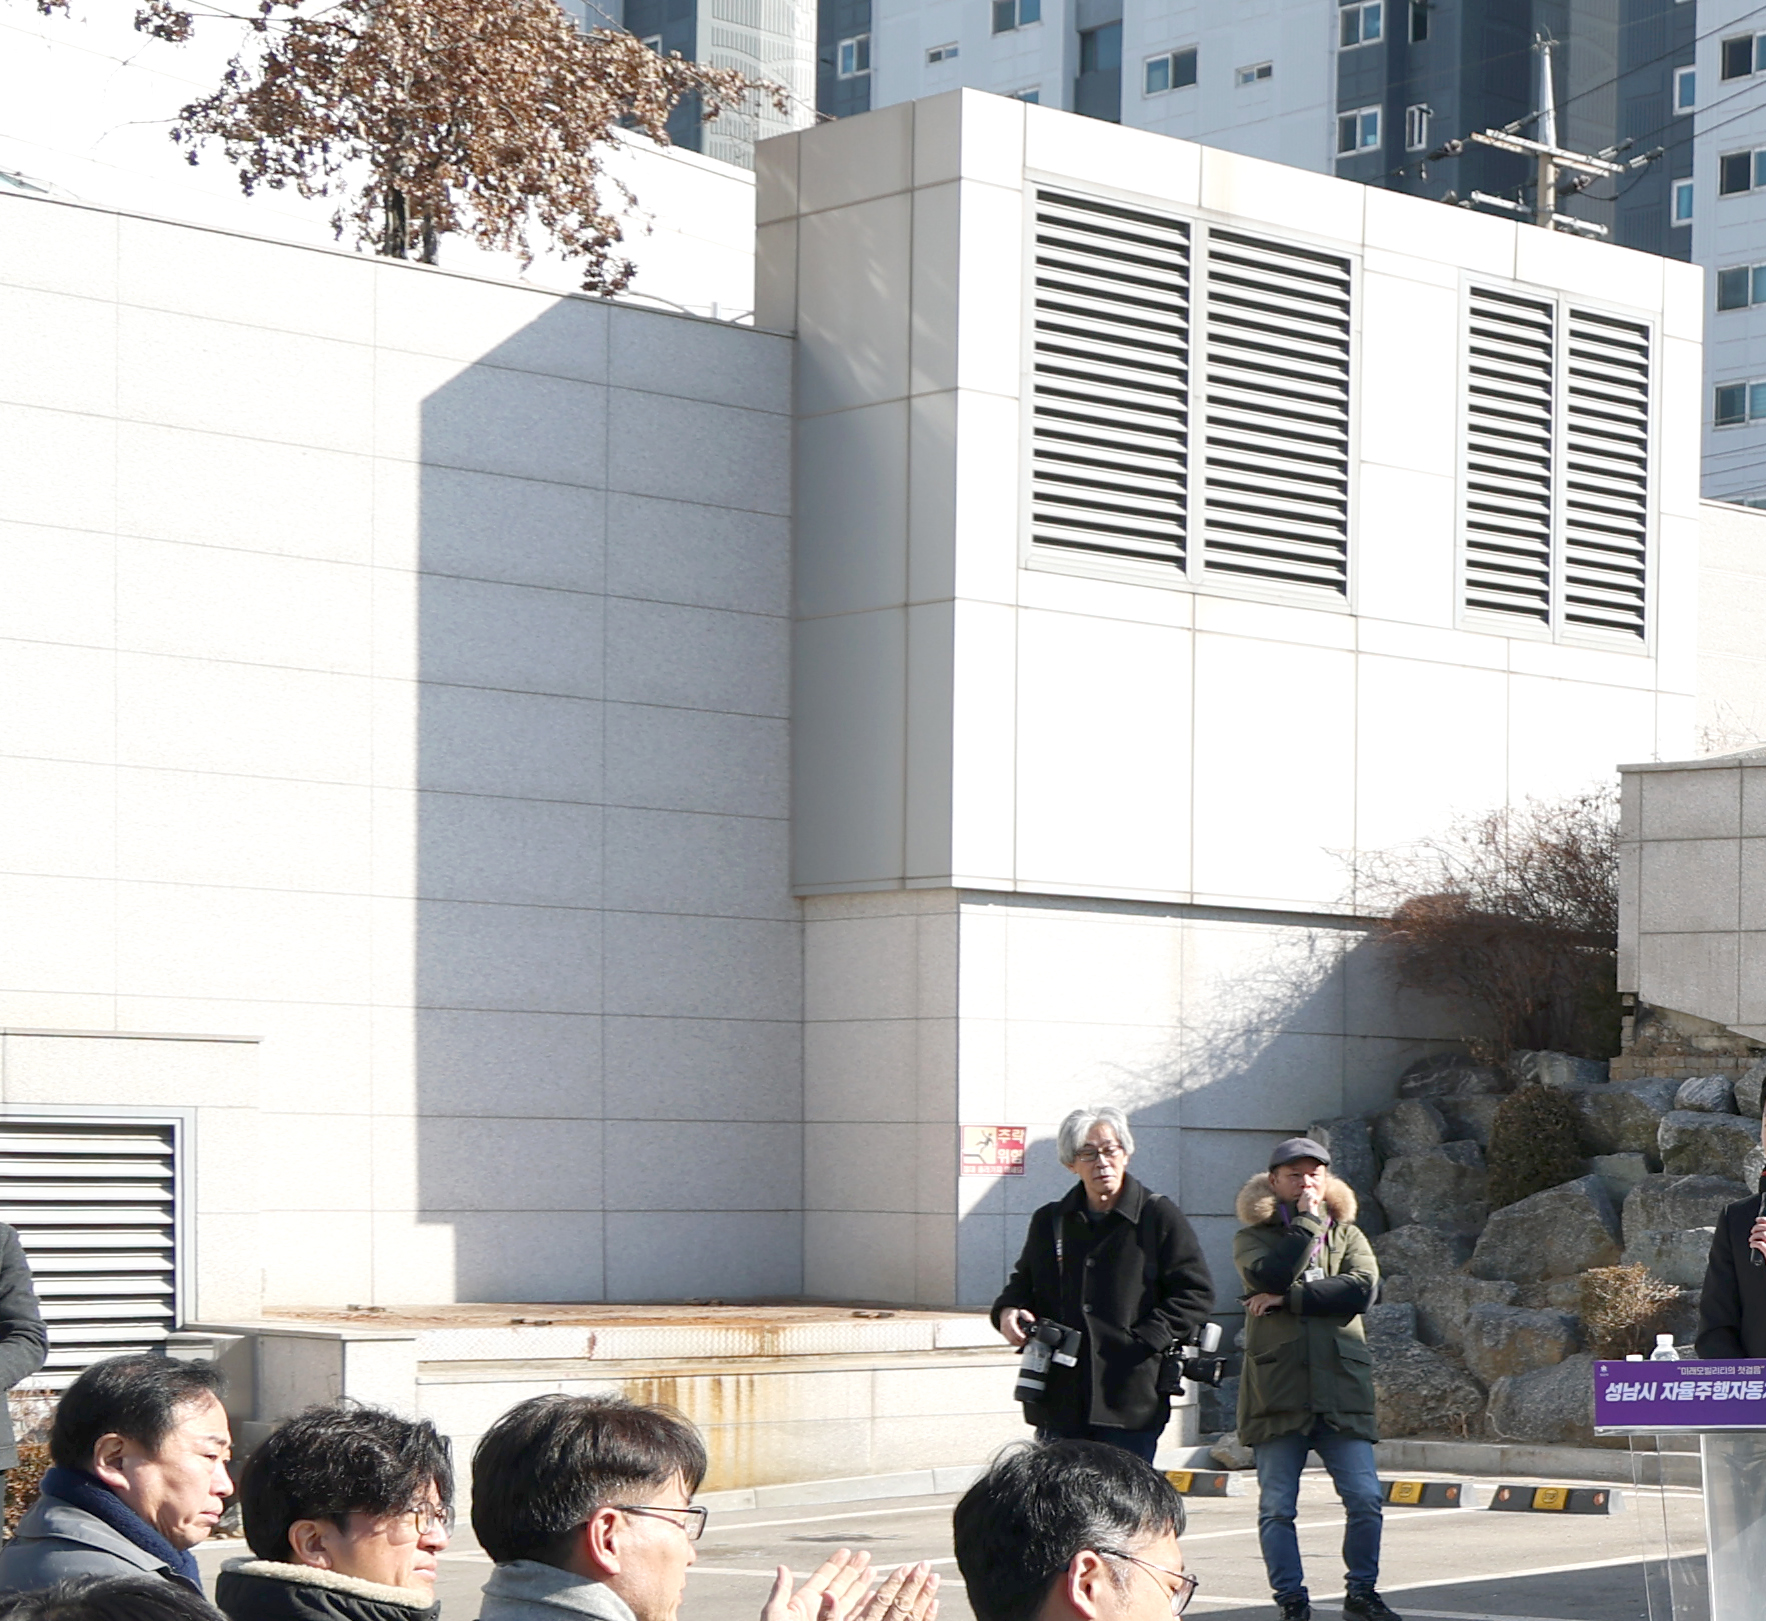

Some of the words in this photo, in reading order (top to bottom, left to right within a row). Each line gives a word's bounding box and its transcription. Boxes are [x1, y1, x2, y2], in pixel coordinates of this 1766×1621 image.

[998, 1129, 1025, 1144] 추락
[997, 1149, 1024, 1164] 위험
[1605, 1380, 1657, 1402] 성남시
